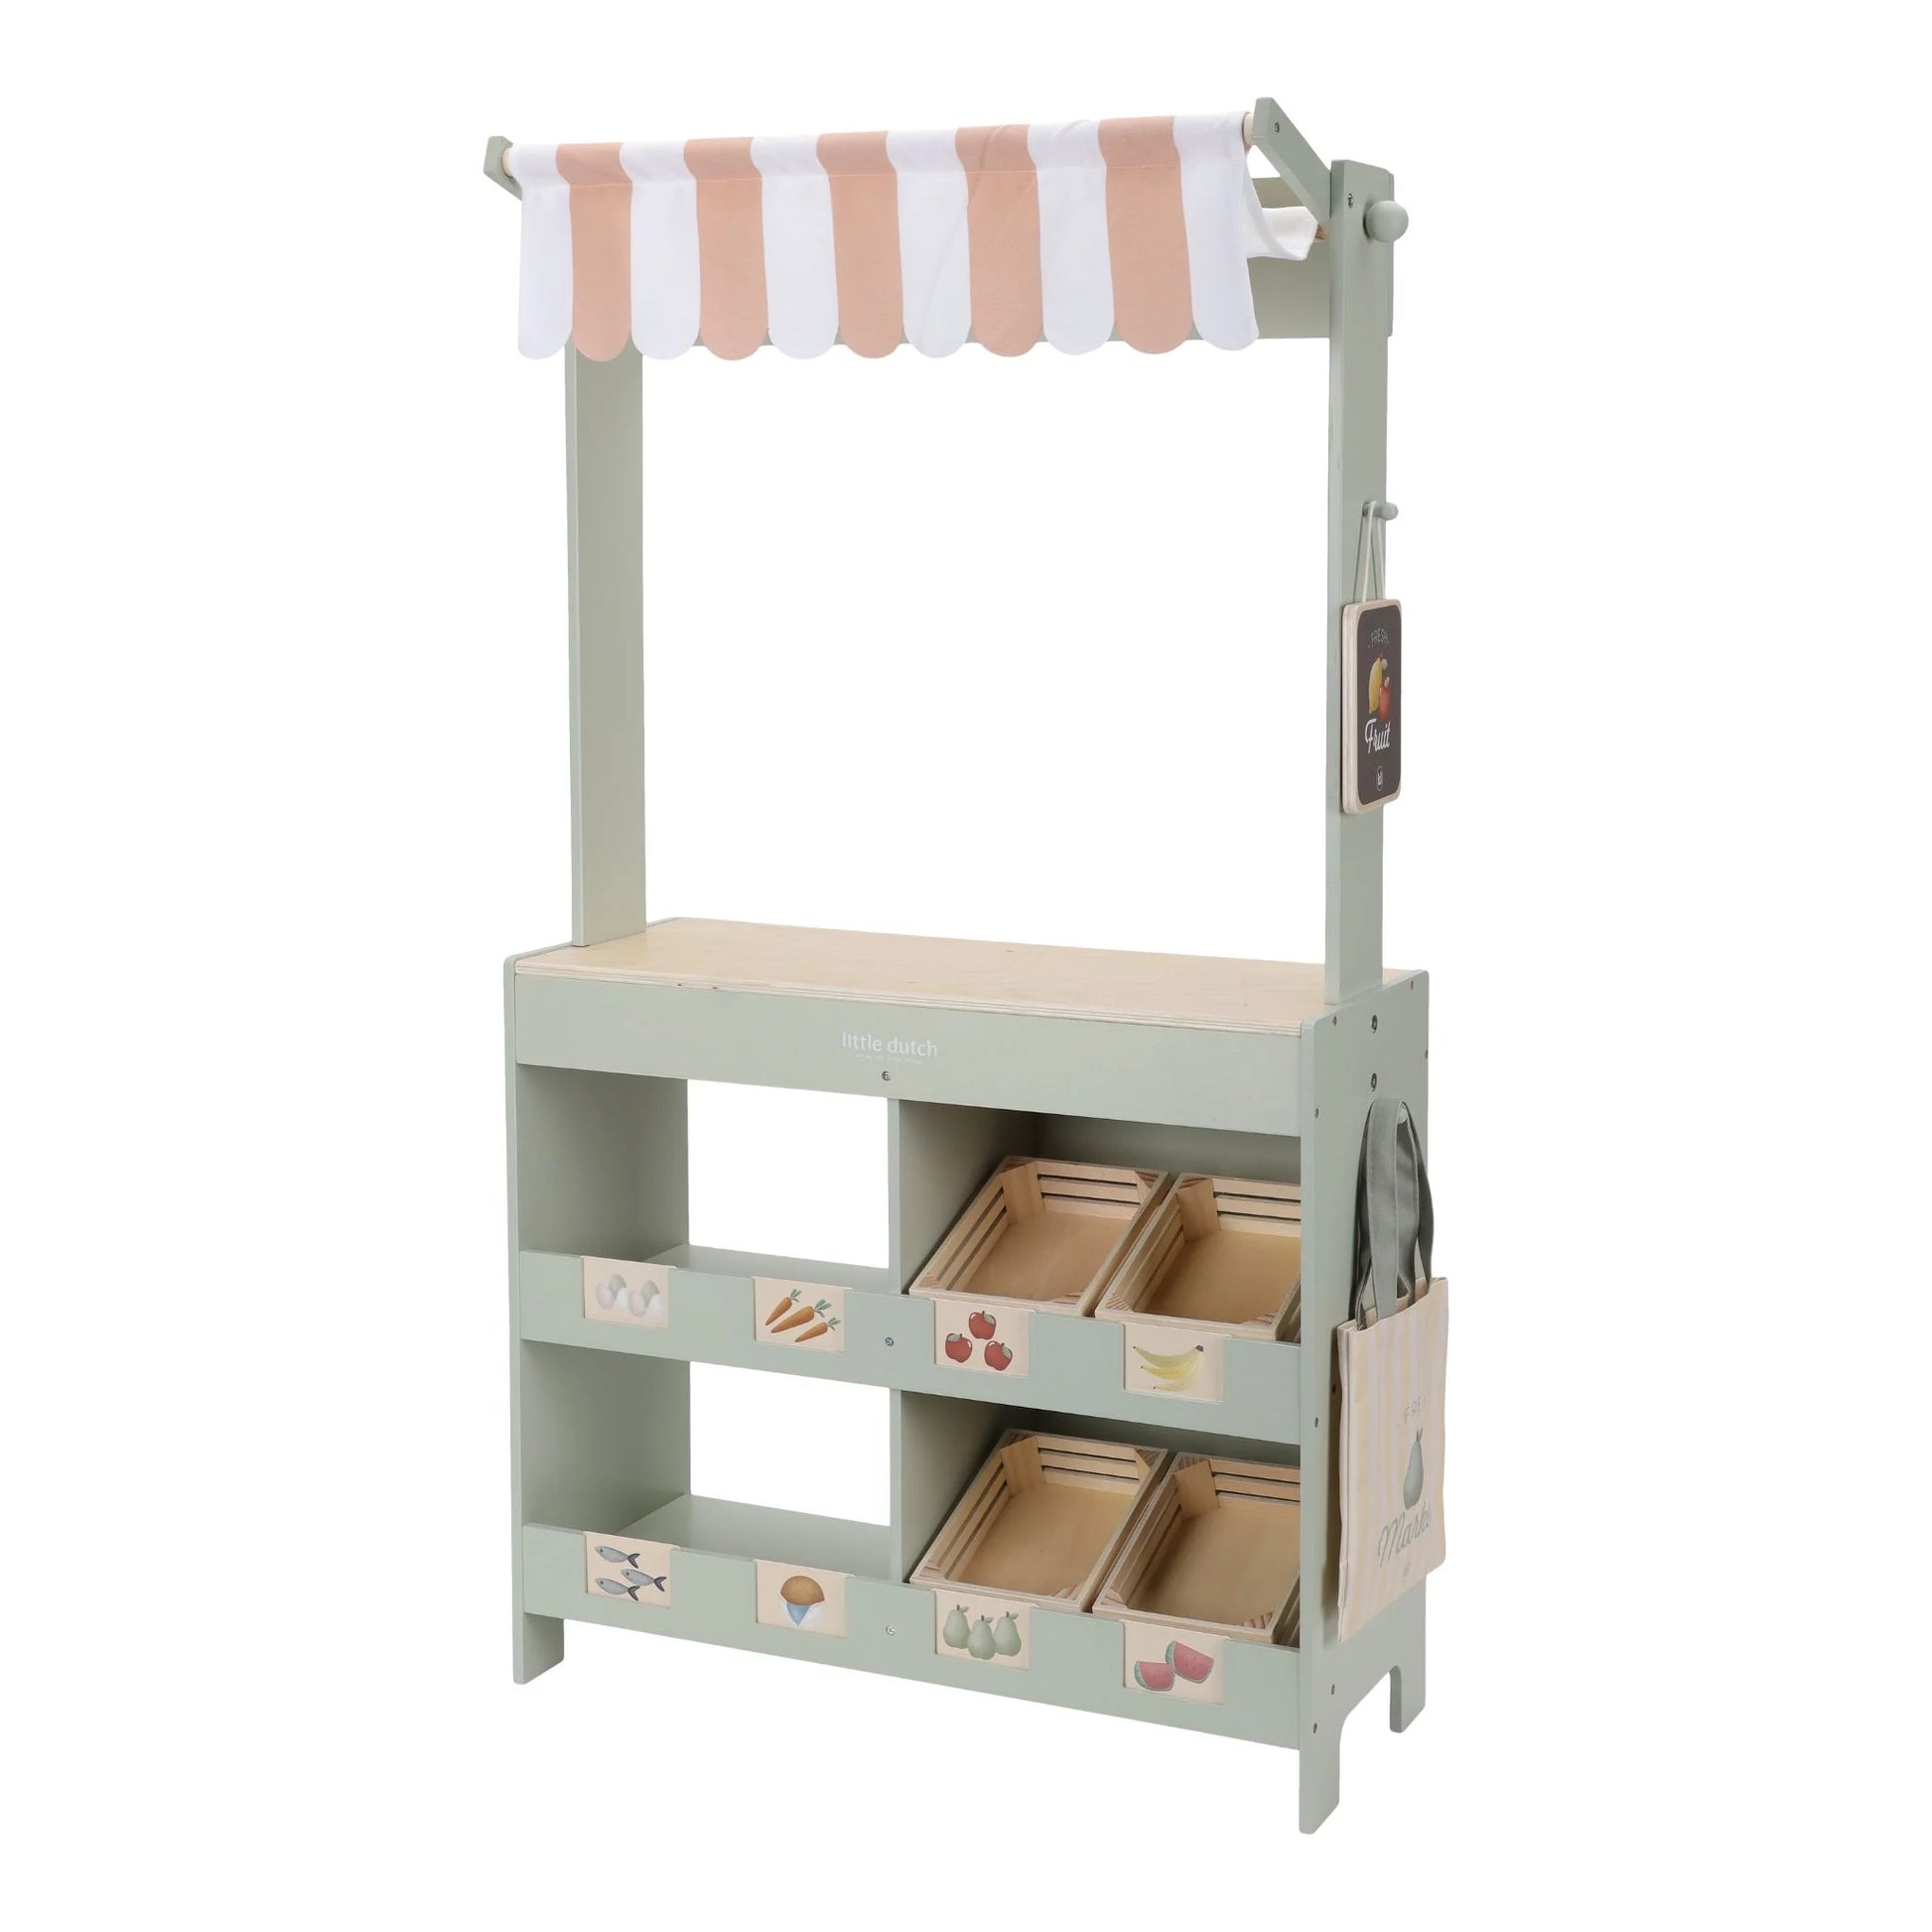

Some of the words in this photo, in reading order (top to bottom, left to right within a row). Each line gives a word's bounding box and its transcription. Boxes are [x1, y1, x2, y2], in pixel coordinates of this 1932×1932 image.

[1365, 718, 1391, 755] Fruit
[842, 1032, 883, 1052] little
[887, 1035, 938, 1057] dutch
